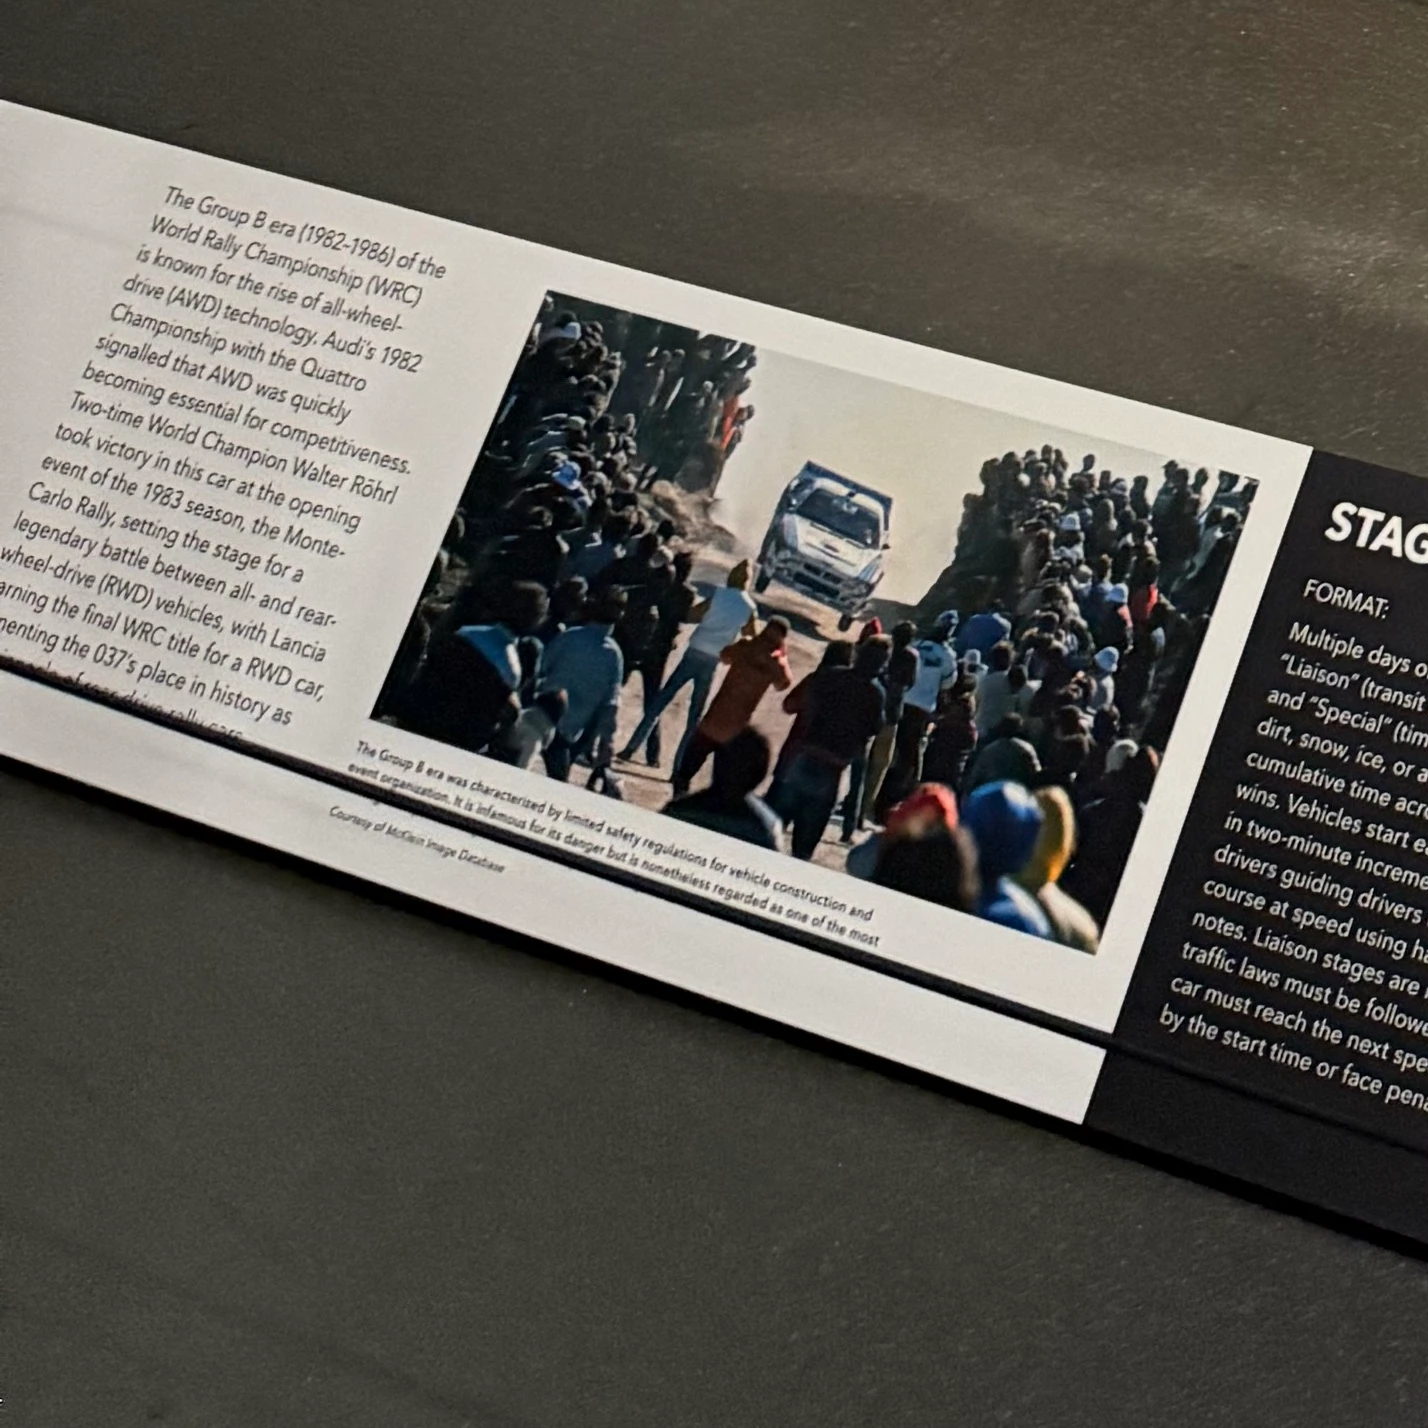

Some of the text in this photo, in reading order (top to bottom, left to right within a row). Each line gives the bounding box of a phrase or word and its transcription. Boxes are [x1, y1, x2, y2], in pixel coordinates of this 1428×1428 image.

[151, 214, 423, 308] World Rally Championship (WRC)
[164, 185, 195, 210] The
[197, 195, 250, 228] Group
[251, 210, 267, 229] B
[268, 220, 296, 238] era
[396, 251, 420, 270] of
[417, 256, 446, 279] the
[110, 302, 367, 391] Championship with the Quattro
[70, 390, 144, 429] Two-time
[147, 413, 201, 445] World
[201, 430, 288, 472] Champion
[292, 456, 349, 489] Walter
[41, 456, 345, 558] event of the 1983 season, the Monte-
[1304, 579, 1389, 620] FORMAT:
[1288, 621, 1364, 659] Multiple
[1367, 644, 1411, 675] days
[1246, 752, 1345, 793] cumulative
[1349, 780, 1391, 807] time
[1256, 716, 1293, 746] dirt,
[1299, 733, 1349, 762] snow,
[1355, 744, 1386, 773] ice,
[1392, 760, 1415, 777] or
[1224, 810, 1243, 832] in
[1246, 819, 1352, 866] two-minute
[1192, 912, 1247, 941] notes.
[1252, 926, 1318, 963] Liaison
[1322, 953, 1385, 984] stages
[1388, 974, 1420, 995] are
[1159, 1002, 1185, 1032] by
[1187, 1014, 1218, 1040] the
[1221, 1030, 1267, 1057] start
[1269, 1042, 1312, 1071] time
[1316, 1061, 1340, 1079] or
[1341, 1062, 1382, 1094] face
